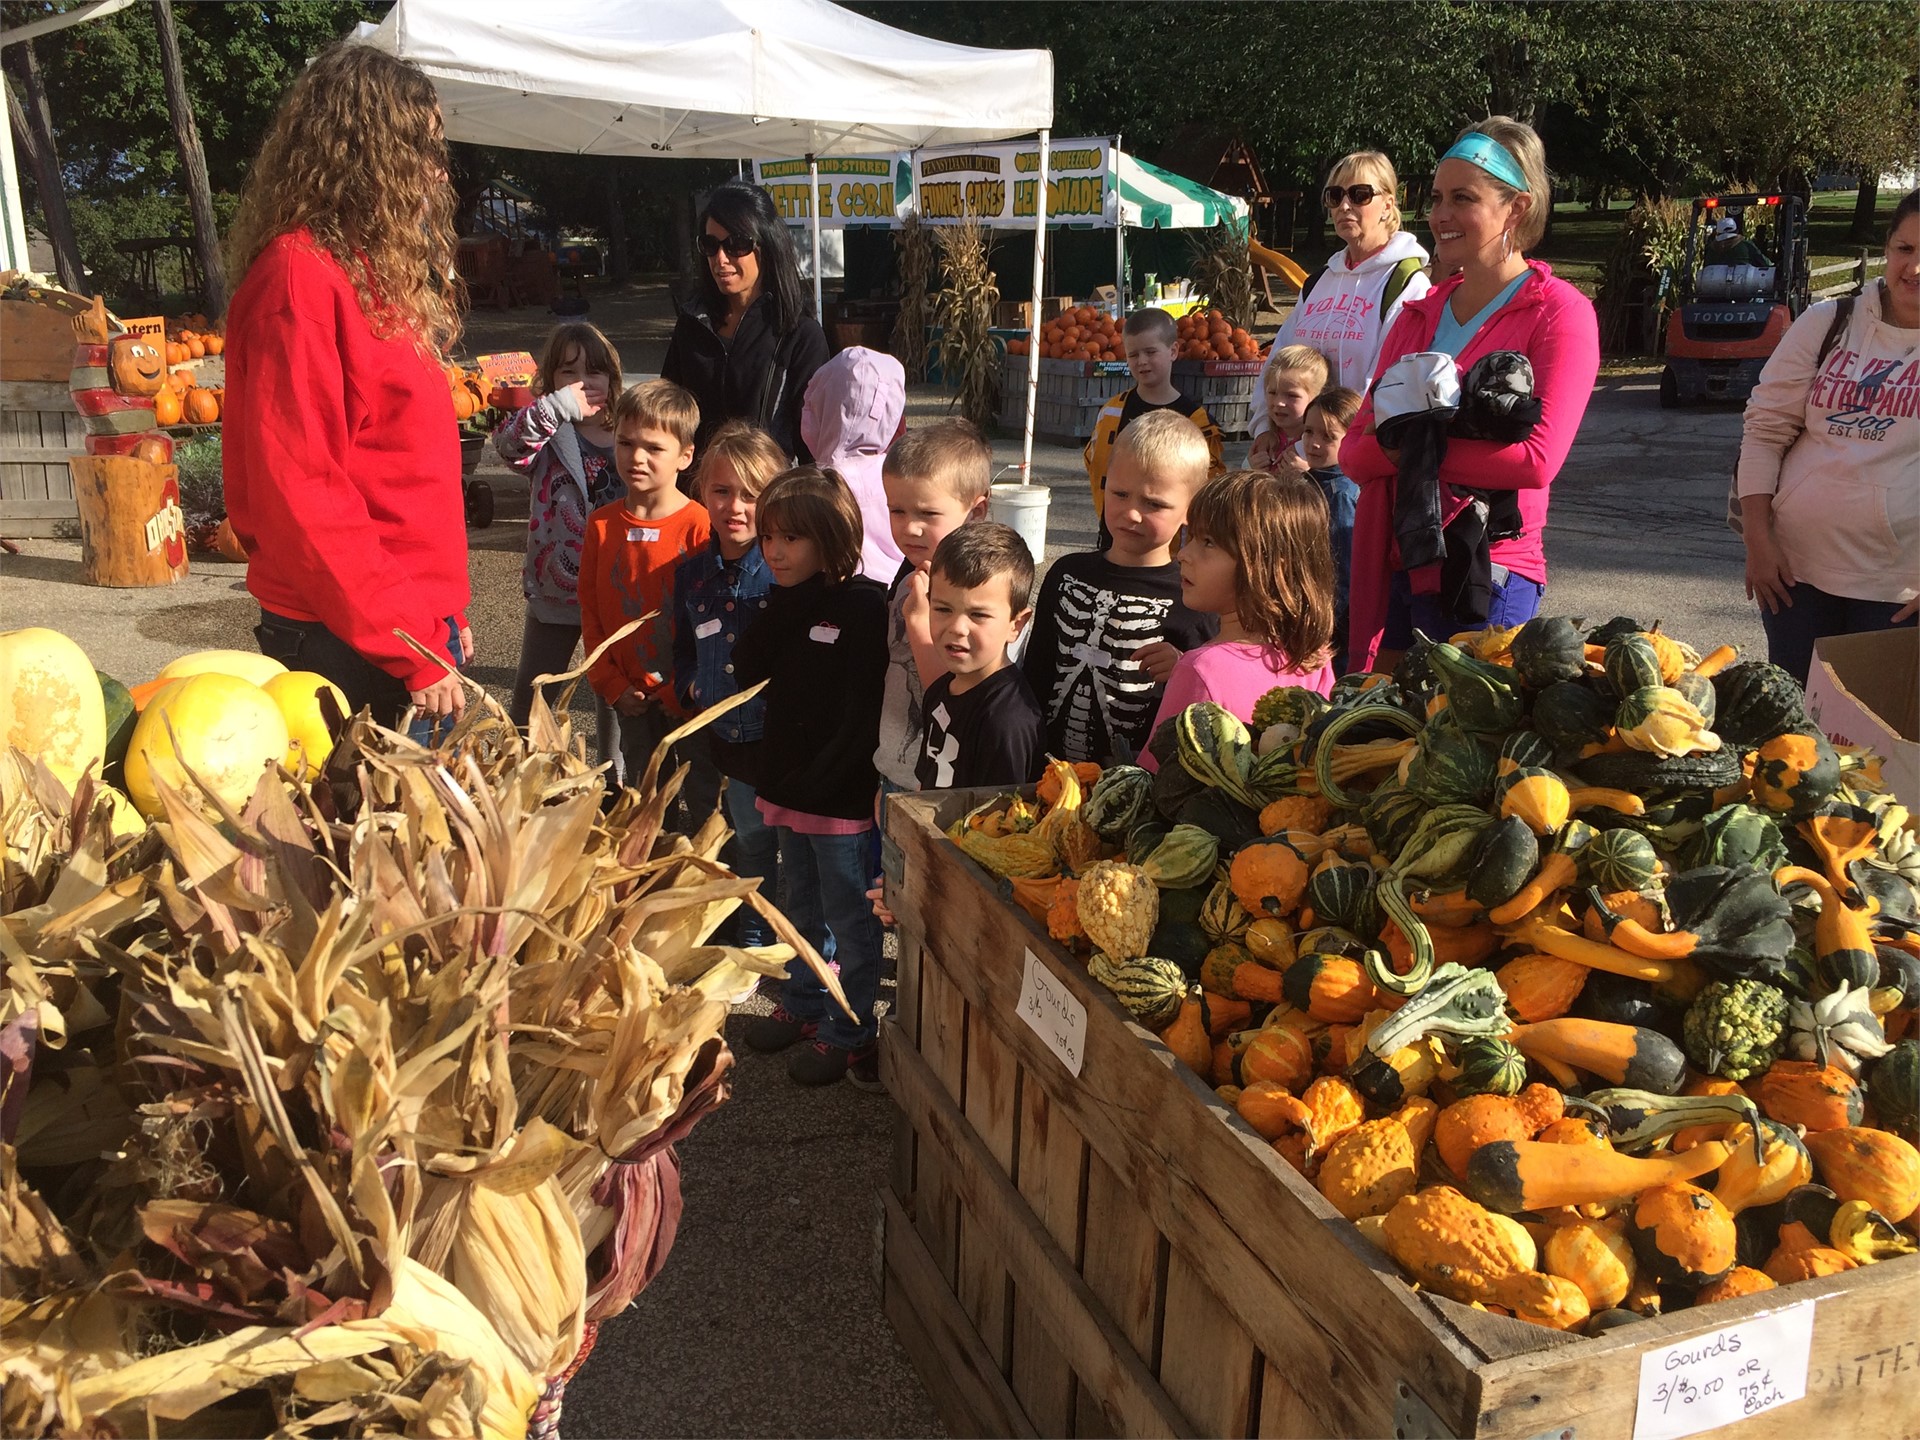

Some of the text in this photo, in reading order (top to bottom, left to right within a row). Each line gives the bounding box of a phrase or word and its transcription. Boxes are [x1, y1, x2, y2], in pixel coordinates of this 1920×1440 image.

[762, 159, 889, 177] PREMIUM AND-STIRRED
[922, 155, 1000, 175] PENNSYLVANIA DUTCH
[764, 182, 896, 218] ETTE CORN
[920, 178, 1005, 218] FUNNEL CAKES
[1693, 312, 1757, 321] TOYOTA
[1311, 330, 1328, 340] THE
[1331, 331, 1365, 341] CURE
[1826, 403, 1897, 431] Zoo
[1827, 424, 1886, 442] EST. 1882
[1665, 1333, 1742, 1371] Gourds
[1739, 1369, 1773, 1399] 75¢
